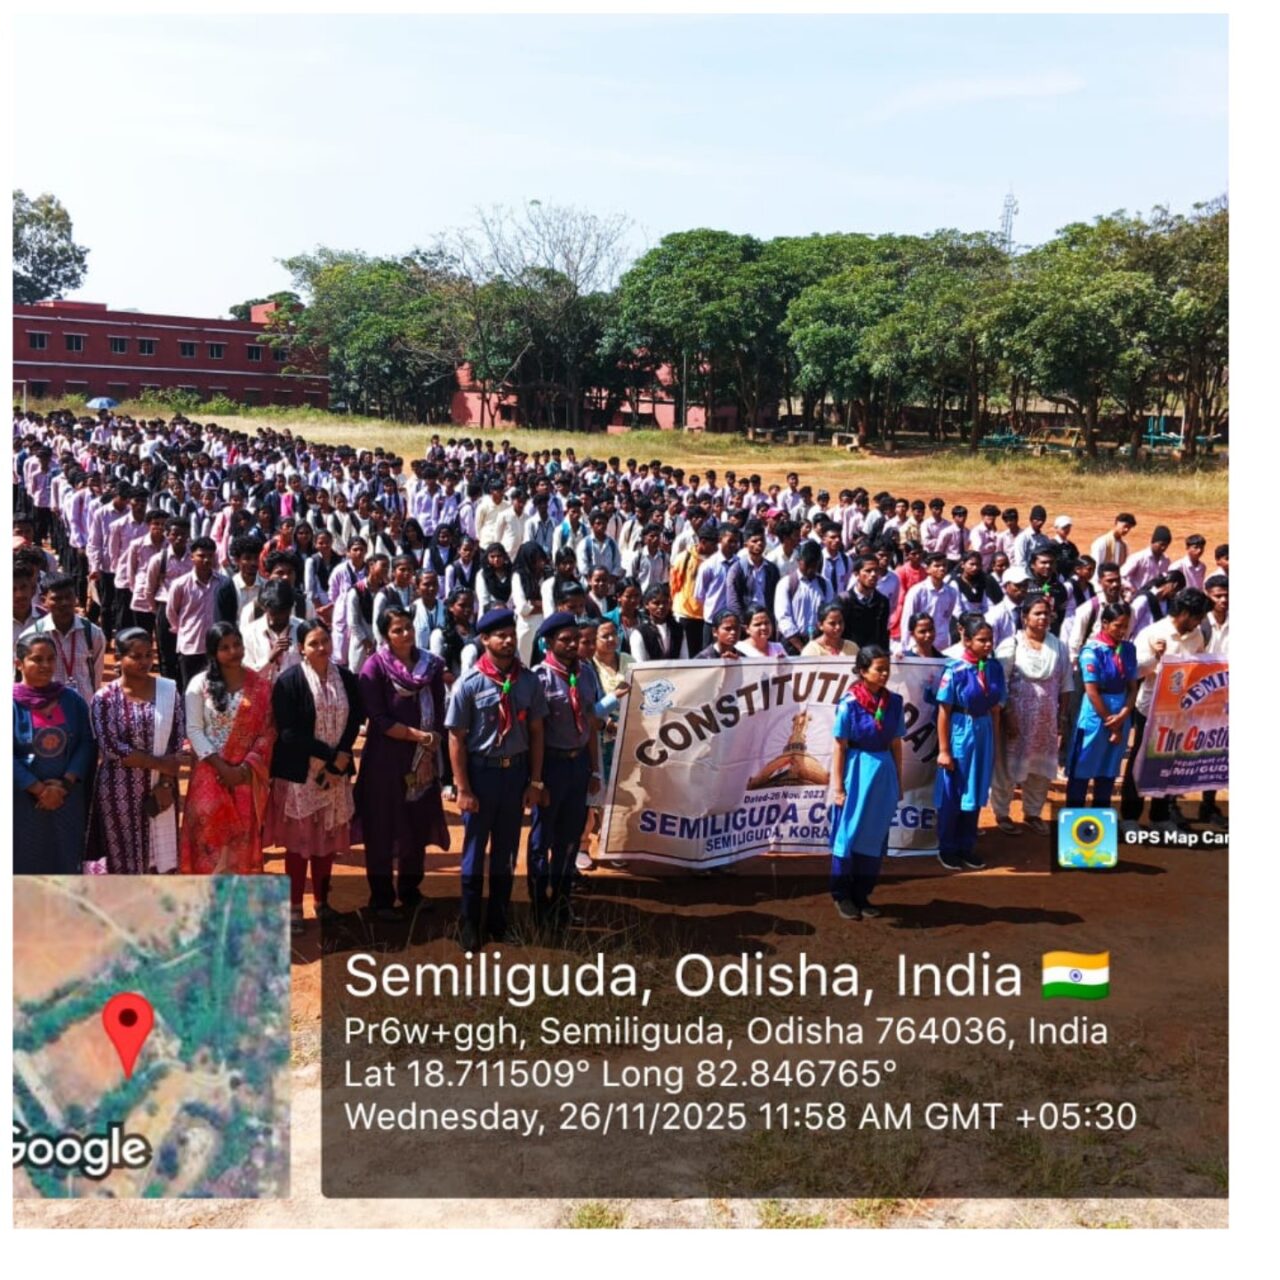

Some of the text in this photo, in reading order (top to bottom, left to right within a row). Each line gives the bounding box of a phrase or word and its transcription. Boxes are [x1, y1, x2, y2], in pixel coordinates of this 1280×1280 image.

[1181, 671, 1229, 710] SEMI
[636, 671, 850, 766] CONSTITUTI
[640, 803, 798, 840] SEMILIGUDA
[789, 825, 830, 839] KORA
